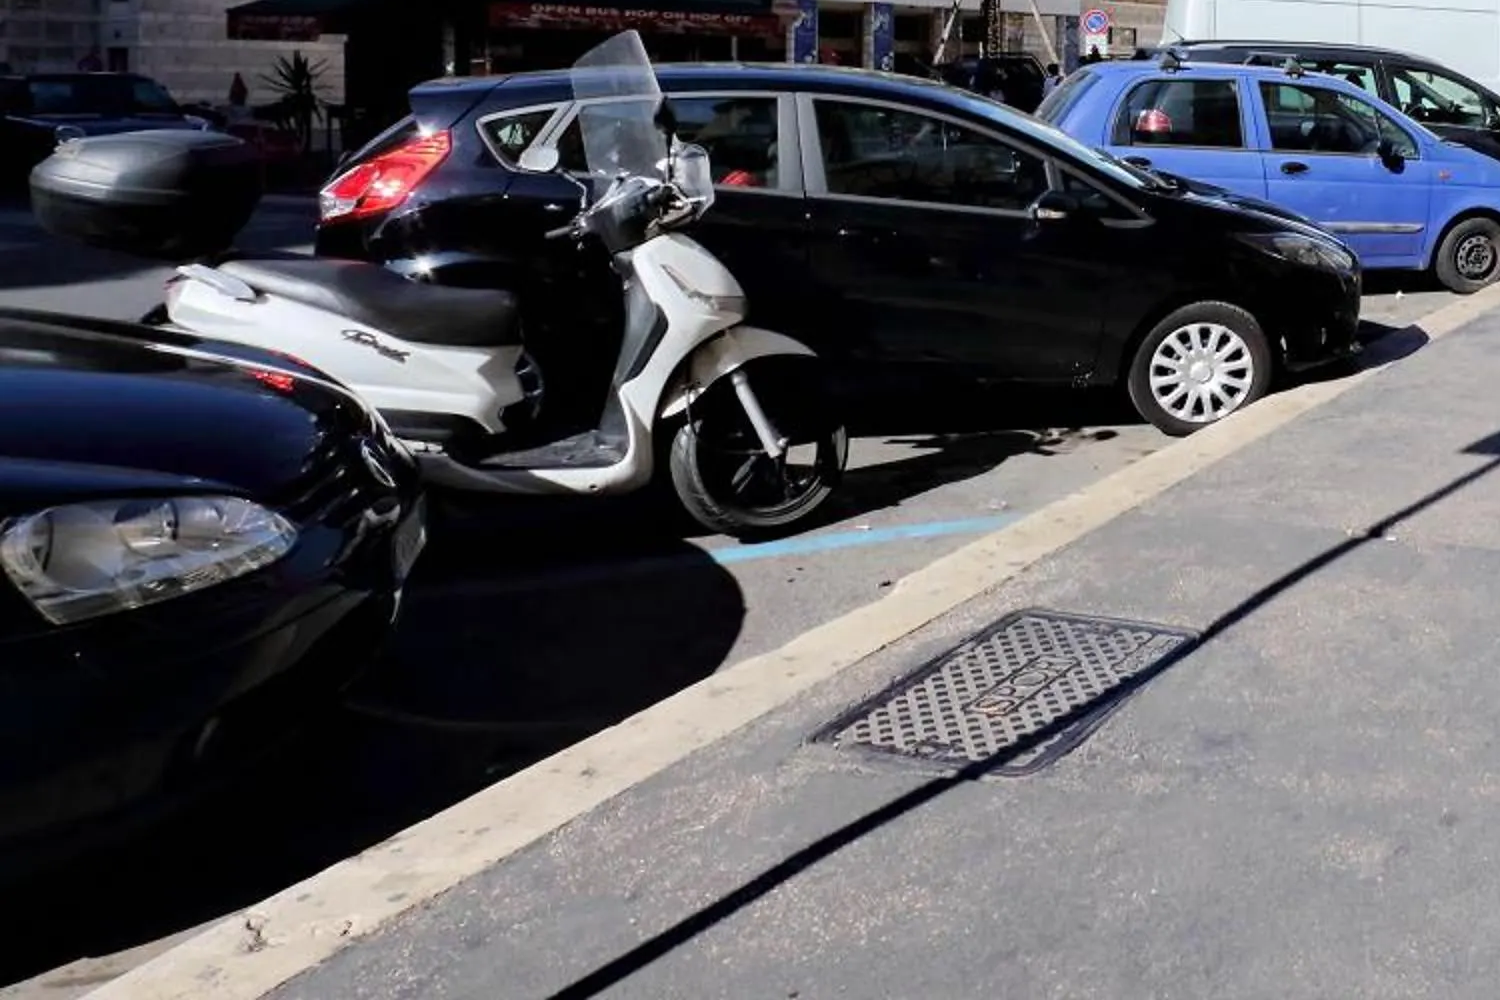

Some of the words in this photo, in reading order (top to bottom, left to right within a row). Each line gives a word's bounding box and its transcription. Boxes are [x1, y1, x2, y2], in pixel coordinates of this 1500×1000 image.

[530, 2, 581, 14] OPEN
[585, 6, 620, 16] BUS
[625, 8, 656, 18] HOP
[725, 13, 752, 23] OFF
